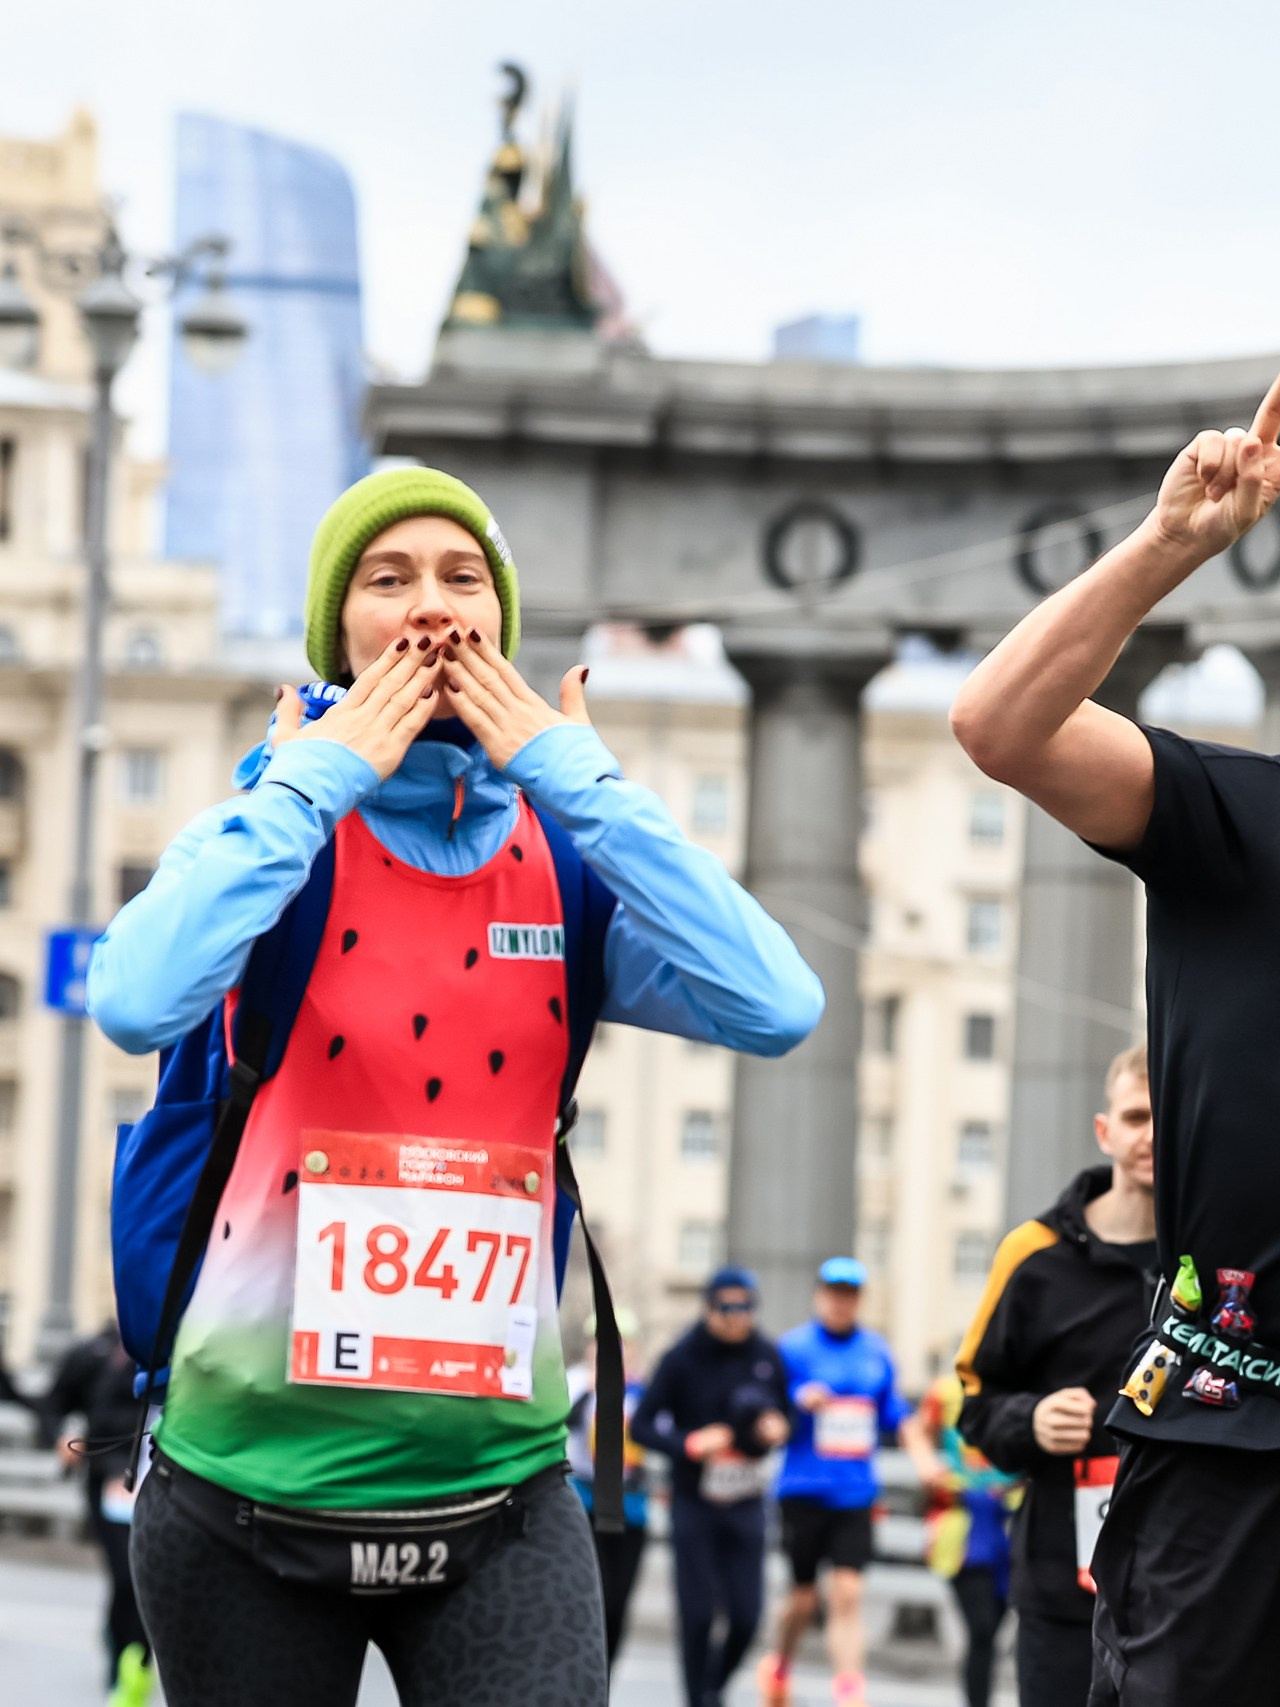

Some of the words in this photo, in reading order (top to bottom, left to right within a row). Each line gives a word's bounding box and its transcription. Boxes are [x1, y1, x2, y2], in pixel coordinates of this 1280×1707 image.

[318, 1221, 532, 1305] 18477
[334, 1332, 360, 1371] E
[350, 1540, 449, 1585] M42.2
